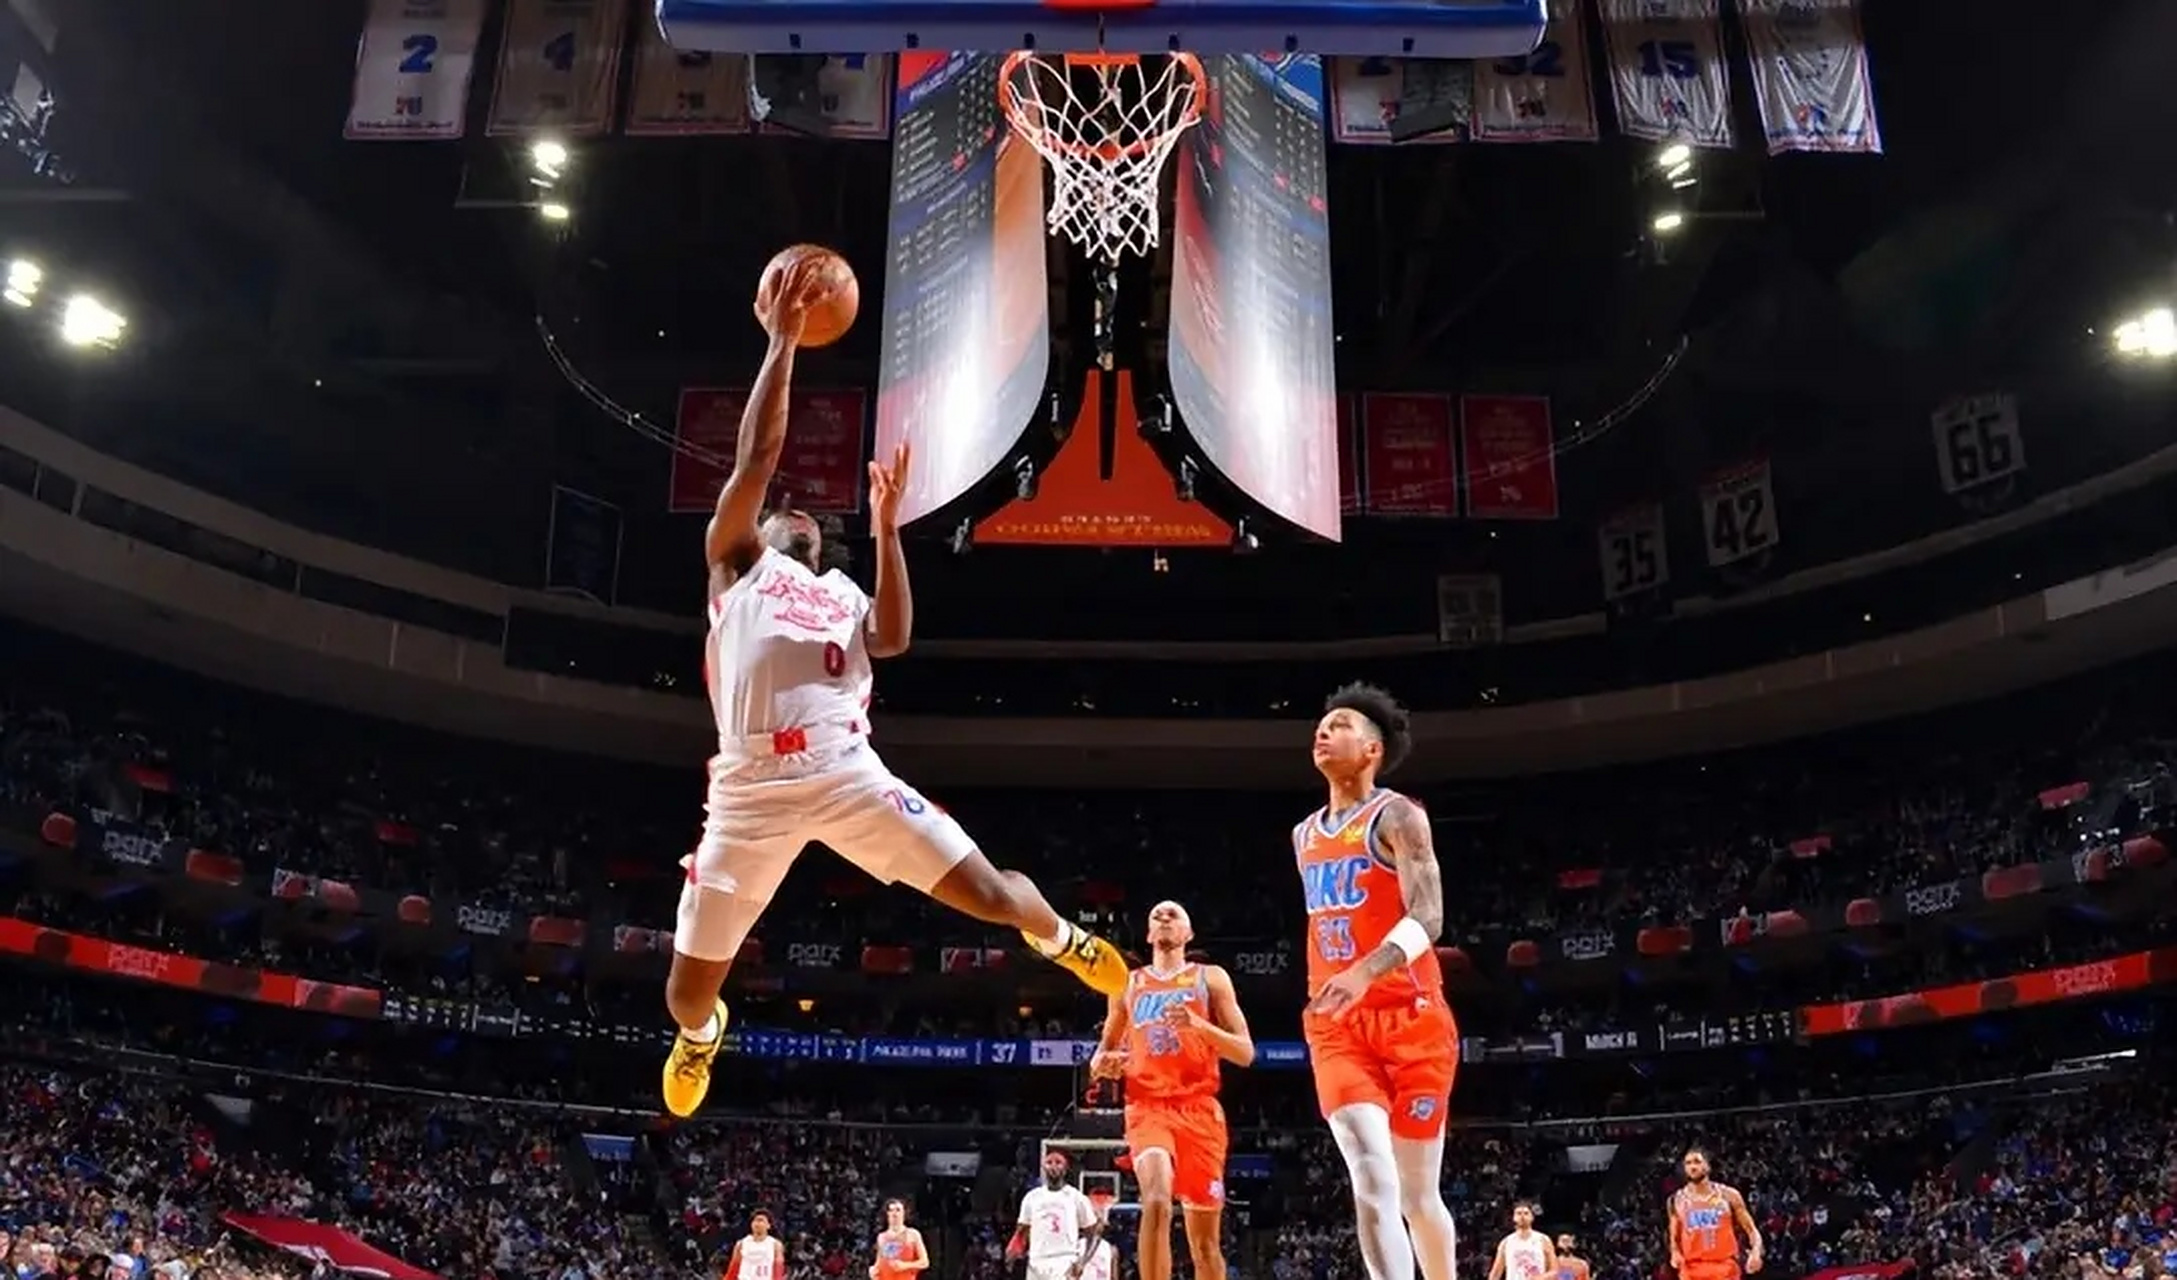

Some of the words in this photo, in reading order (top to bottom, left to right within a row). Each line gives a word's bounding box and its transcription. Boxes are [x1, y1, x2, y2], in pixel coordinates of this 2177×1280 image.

[399, 34, 437, 73] 2
[544, 32, 575, 73] 4
[1641, 41, 1695, 78] 15
[1948, 413, 2011, 484] 66
[1713, 489, 1768, 554] 42
[1613, 532, 1656, 592] 35
[823, 640, 846, 678] 0
[883, 787, 925, 815] 76
[788, 942, 842, 962] parx
[992, 1042, 1017, 1063] 37
